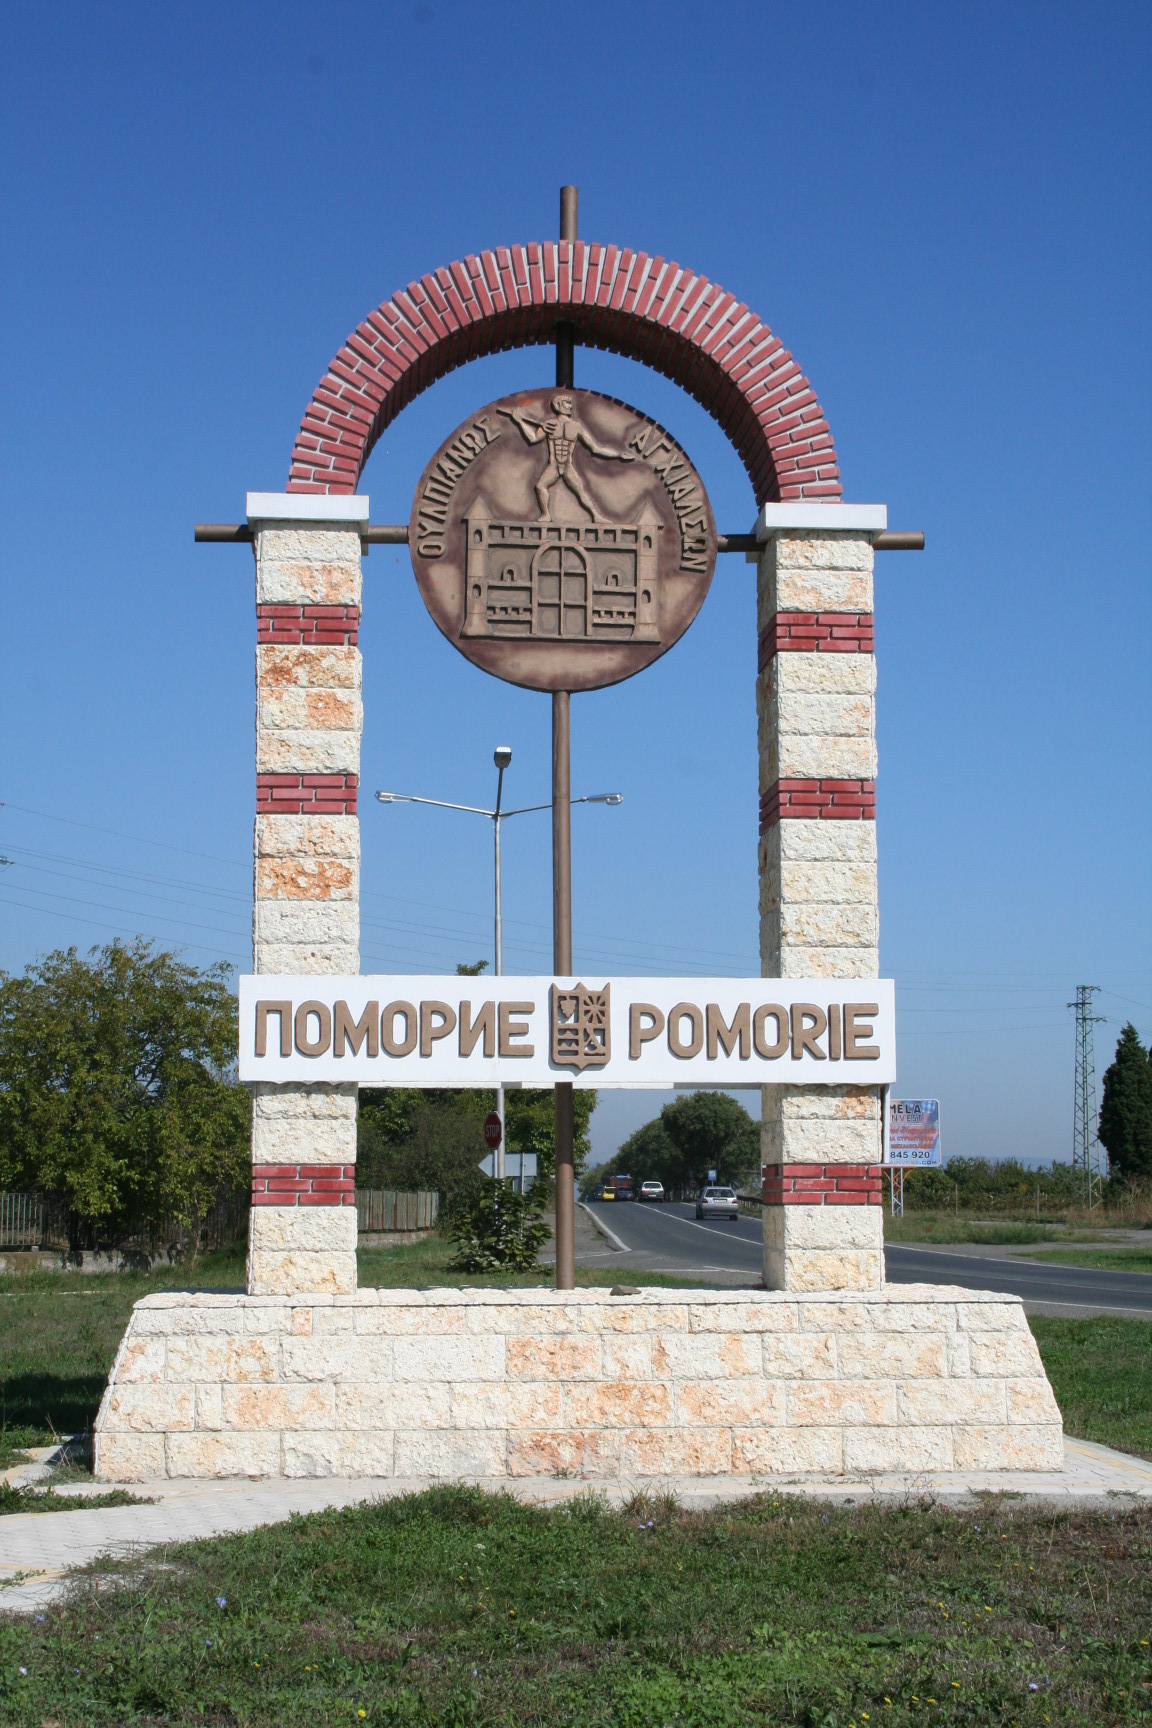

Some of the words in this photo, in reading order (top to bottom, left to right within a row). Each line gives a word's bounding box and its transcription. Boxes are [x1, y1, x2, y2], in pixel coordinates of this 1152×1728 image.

[255, 1000, 535, 1057] ПОМОРИЕ
[629, 1002, 880, 1060] POMORIE
[486, 1124, 499, 1138] STOP
[890, 1151, 909, 1159] 845
[912, 1151, 930, 1159] 920
